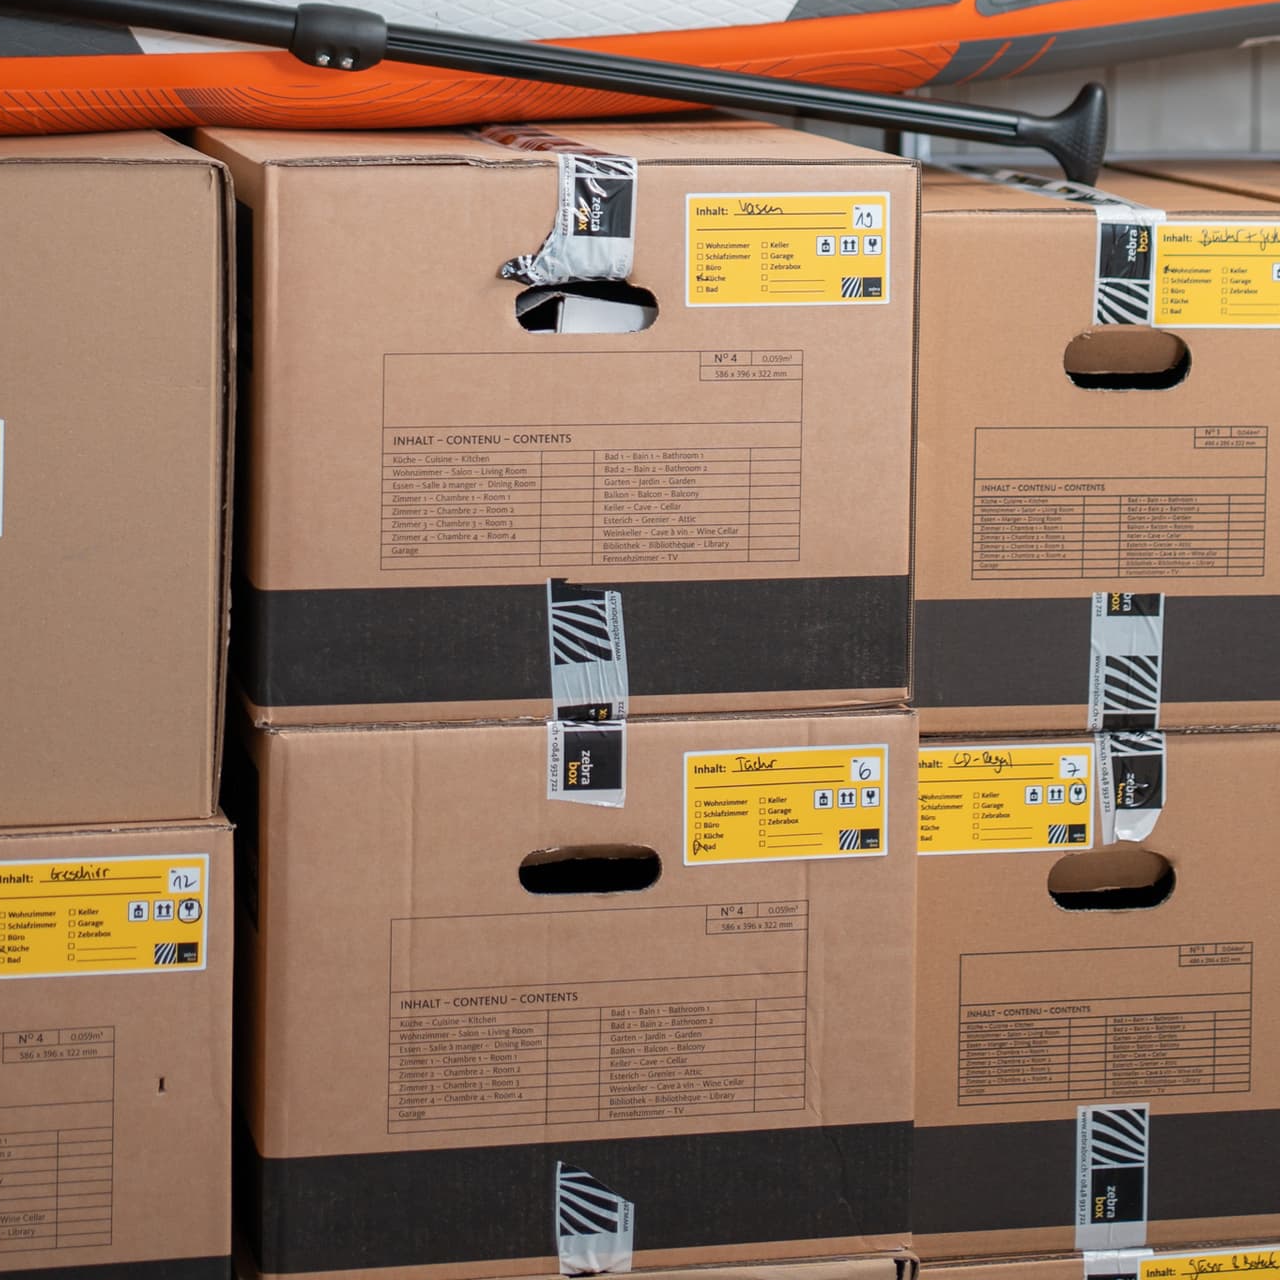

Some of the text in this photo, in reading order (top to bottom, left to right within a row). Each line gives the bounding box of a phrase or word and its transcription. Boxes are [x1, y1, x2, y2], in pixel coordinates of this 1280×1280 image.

[591, 197, 604, 232] zebra
[697, 207, 728, 215] Inhalt:
[1137, 230, 1148, 253] box
[1163, 234, 1192, 242] Inhalt:
[1126, 229, 1138, 262] zebra
[731, 354, 737, 362] 4
[393, 434, 571, 445] INHALT CONTENU CONTENTS
[981, 483, 1010, 492] INHALT
[1017, 484, 1056, 492] CONTENU
[581, 749, 594, 785] zebra
[694, 764, 726, 774] Inhalt:
[858, 762, 872, 780] 6
[918, 760, 943, 768] nhalt:
[568, 762, 581, 785] box
[0, 874, 33, 884] Inhalt:
[401, 992, 578, 1009] INHALT CONTENU CONTENTS
[1094, 1196, 1106, 1218] box
[1106, 1185, 1118, 1219] zebra
[1147, 1268, 1176, 1277] Inhalt:
